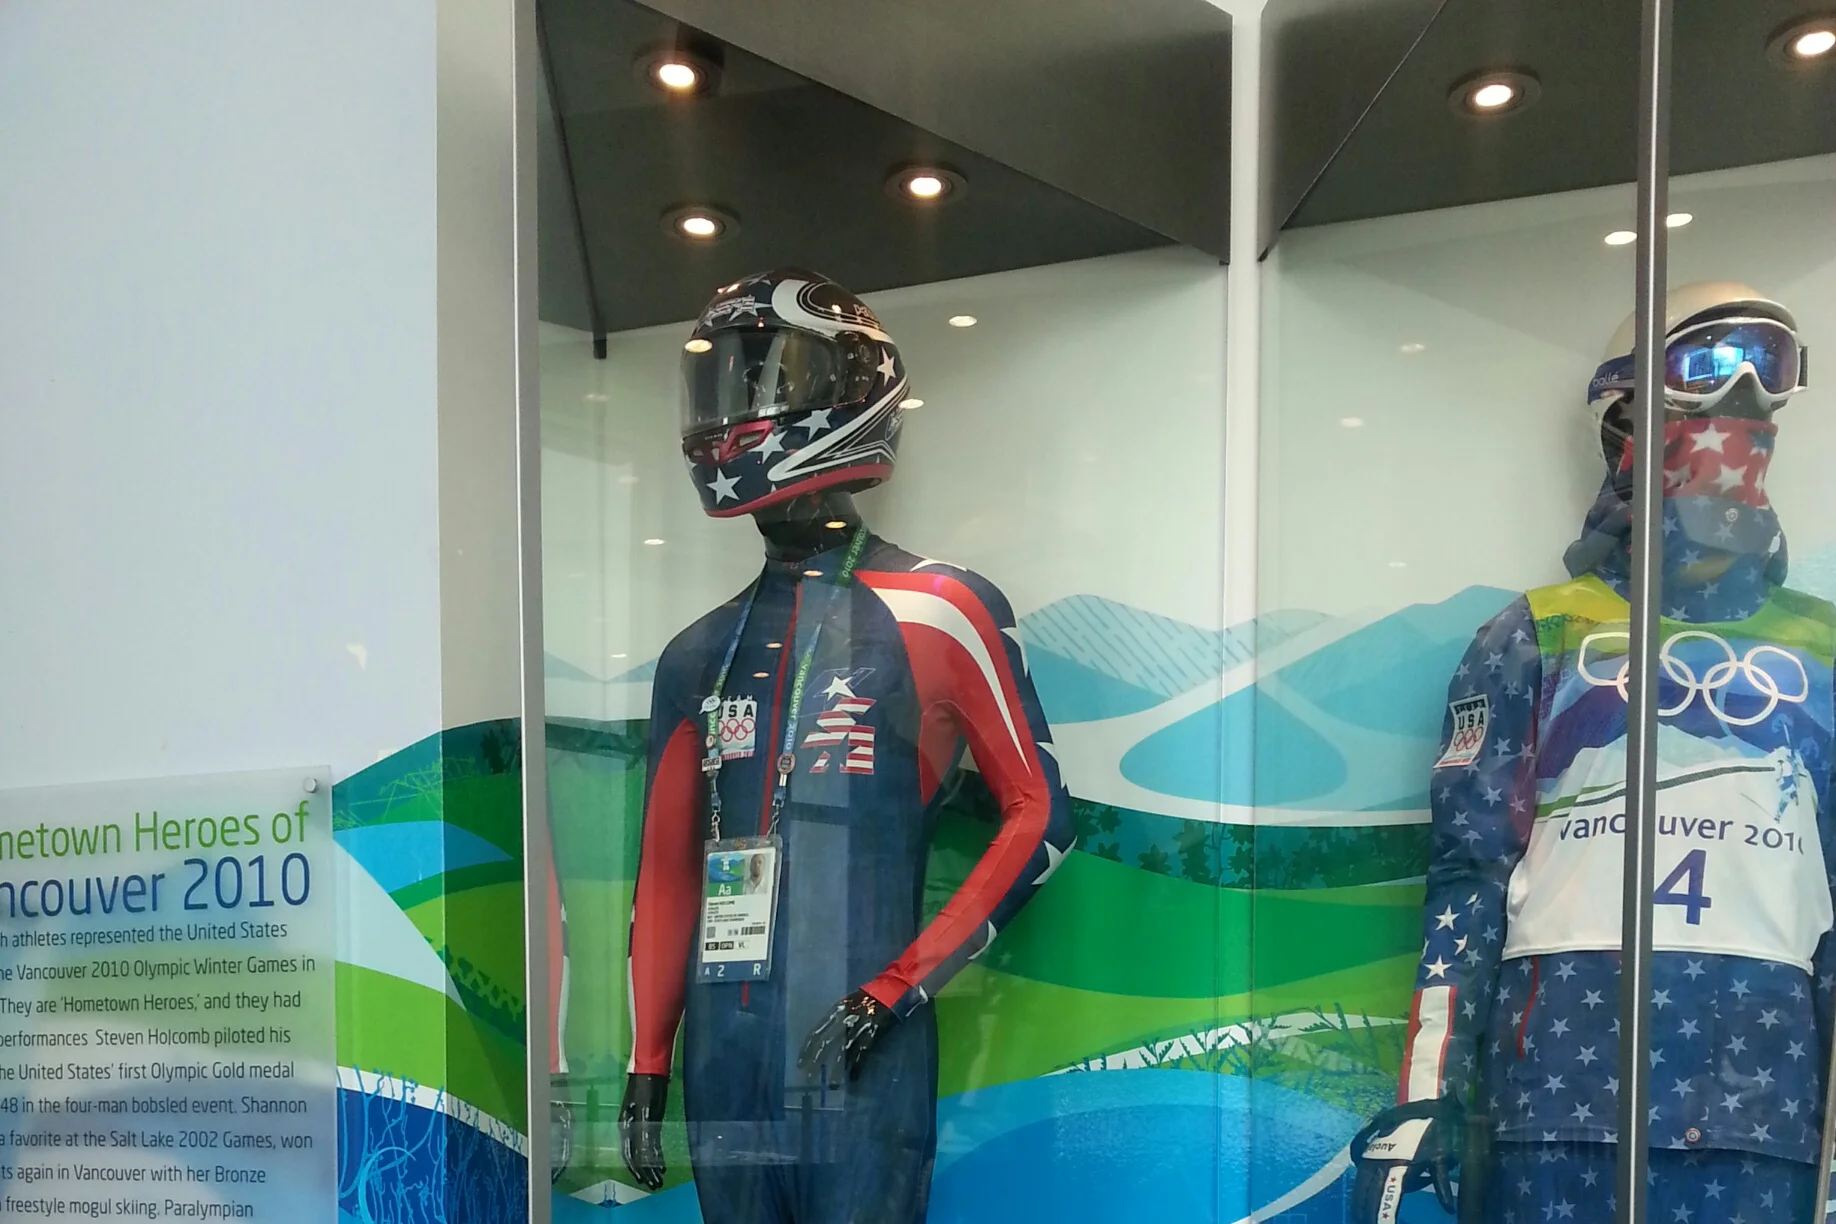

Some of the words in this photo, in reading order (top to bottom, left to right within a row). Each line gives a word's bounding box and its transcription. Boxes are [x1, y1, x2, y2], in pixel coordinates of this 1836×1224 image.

[1458, 710, 1485, 730] USA
[136, 811, 259, 851] Heroes
[272, 801, 308, 843] of
[1559, 812, 1734, 843] vancuver
[184, 853, 309, 910] 2010
[717, 883, 732, 897] Aa
[1653, 848, 1712, 926] 4
[12, 931, 66, 947] athletes
[71, 926, 154, 947] represented
[159, 925, 182, 941] the
[188, 922, 235, 940] United
[241, 921, 287, 938] States
[17, 965, 86, 980] Vancouver
[92, 961, 129, 978] 2010
[134, 959, 190, 980] Olympic
[194, 958, 242, 974] Winter
[247, 956, 297, 973] Games
[303, 955, 315, 971] in
[716, 964, 726, 978] 2
[752, 962, 762, 976] R
[0, 998, 32, 1017] They
[36, 1001, 56, 1013] are
[204, 992, 230, 1009] and
[236, 992, 269, 1012] they
[274, 991, 300, 1007] had
[96, 1029, 143, 1045] Steven
[149, 1028, 209, 1045] Holcomb
[215, 1027, 264, 1047] piloted
[270, 1027, 290, 1043] his
[19, 1064, 63, 1080] United
[118, 1063, 146, 1079] first
[151, 1062, 207, 1083] Olympic
[213, 1062, 244, 1078] Gold
[250, 1062, 293, 1078] medal
[23, 1097, 33, 1112] in
[39, 1098, 60, 1113] the
[65, 1097, 127, 1113] four-man
[132, 1097, 187, 1113] bobsled
[242, 1096, 306, 1113] Shannon
[10, 1130, 61, 1146] favorite
[66, 1133, 78, 1146] at
[84, 1131, 106, 1147] the
[110, 1131, 136, 1147] Salt
[142, 1131, 174, 1147] Lake
[179, 1131, 218, 1148] 2002
[223, 1131, 275, 1149] Games,
[281, 1136, 312, 1148] won
[17, 1164, 53, 1183] again
[58, 1165, 69, 1179] in
[74, 1165, 146, 1181] Vancouver
[151, 1166, 182, 1181] with
[187, 1166, 210, 1182] her
[216, 1166, 266, 1183] Bronze
[6, 1196, 65, 1217] freestyle
[70, 1199, 111, 1218] mogul
[116, 1199, 159, 1219] skiing.
[165, 1199, 253, 1220] Paralympian
